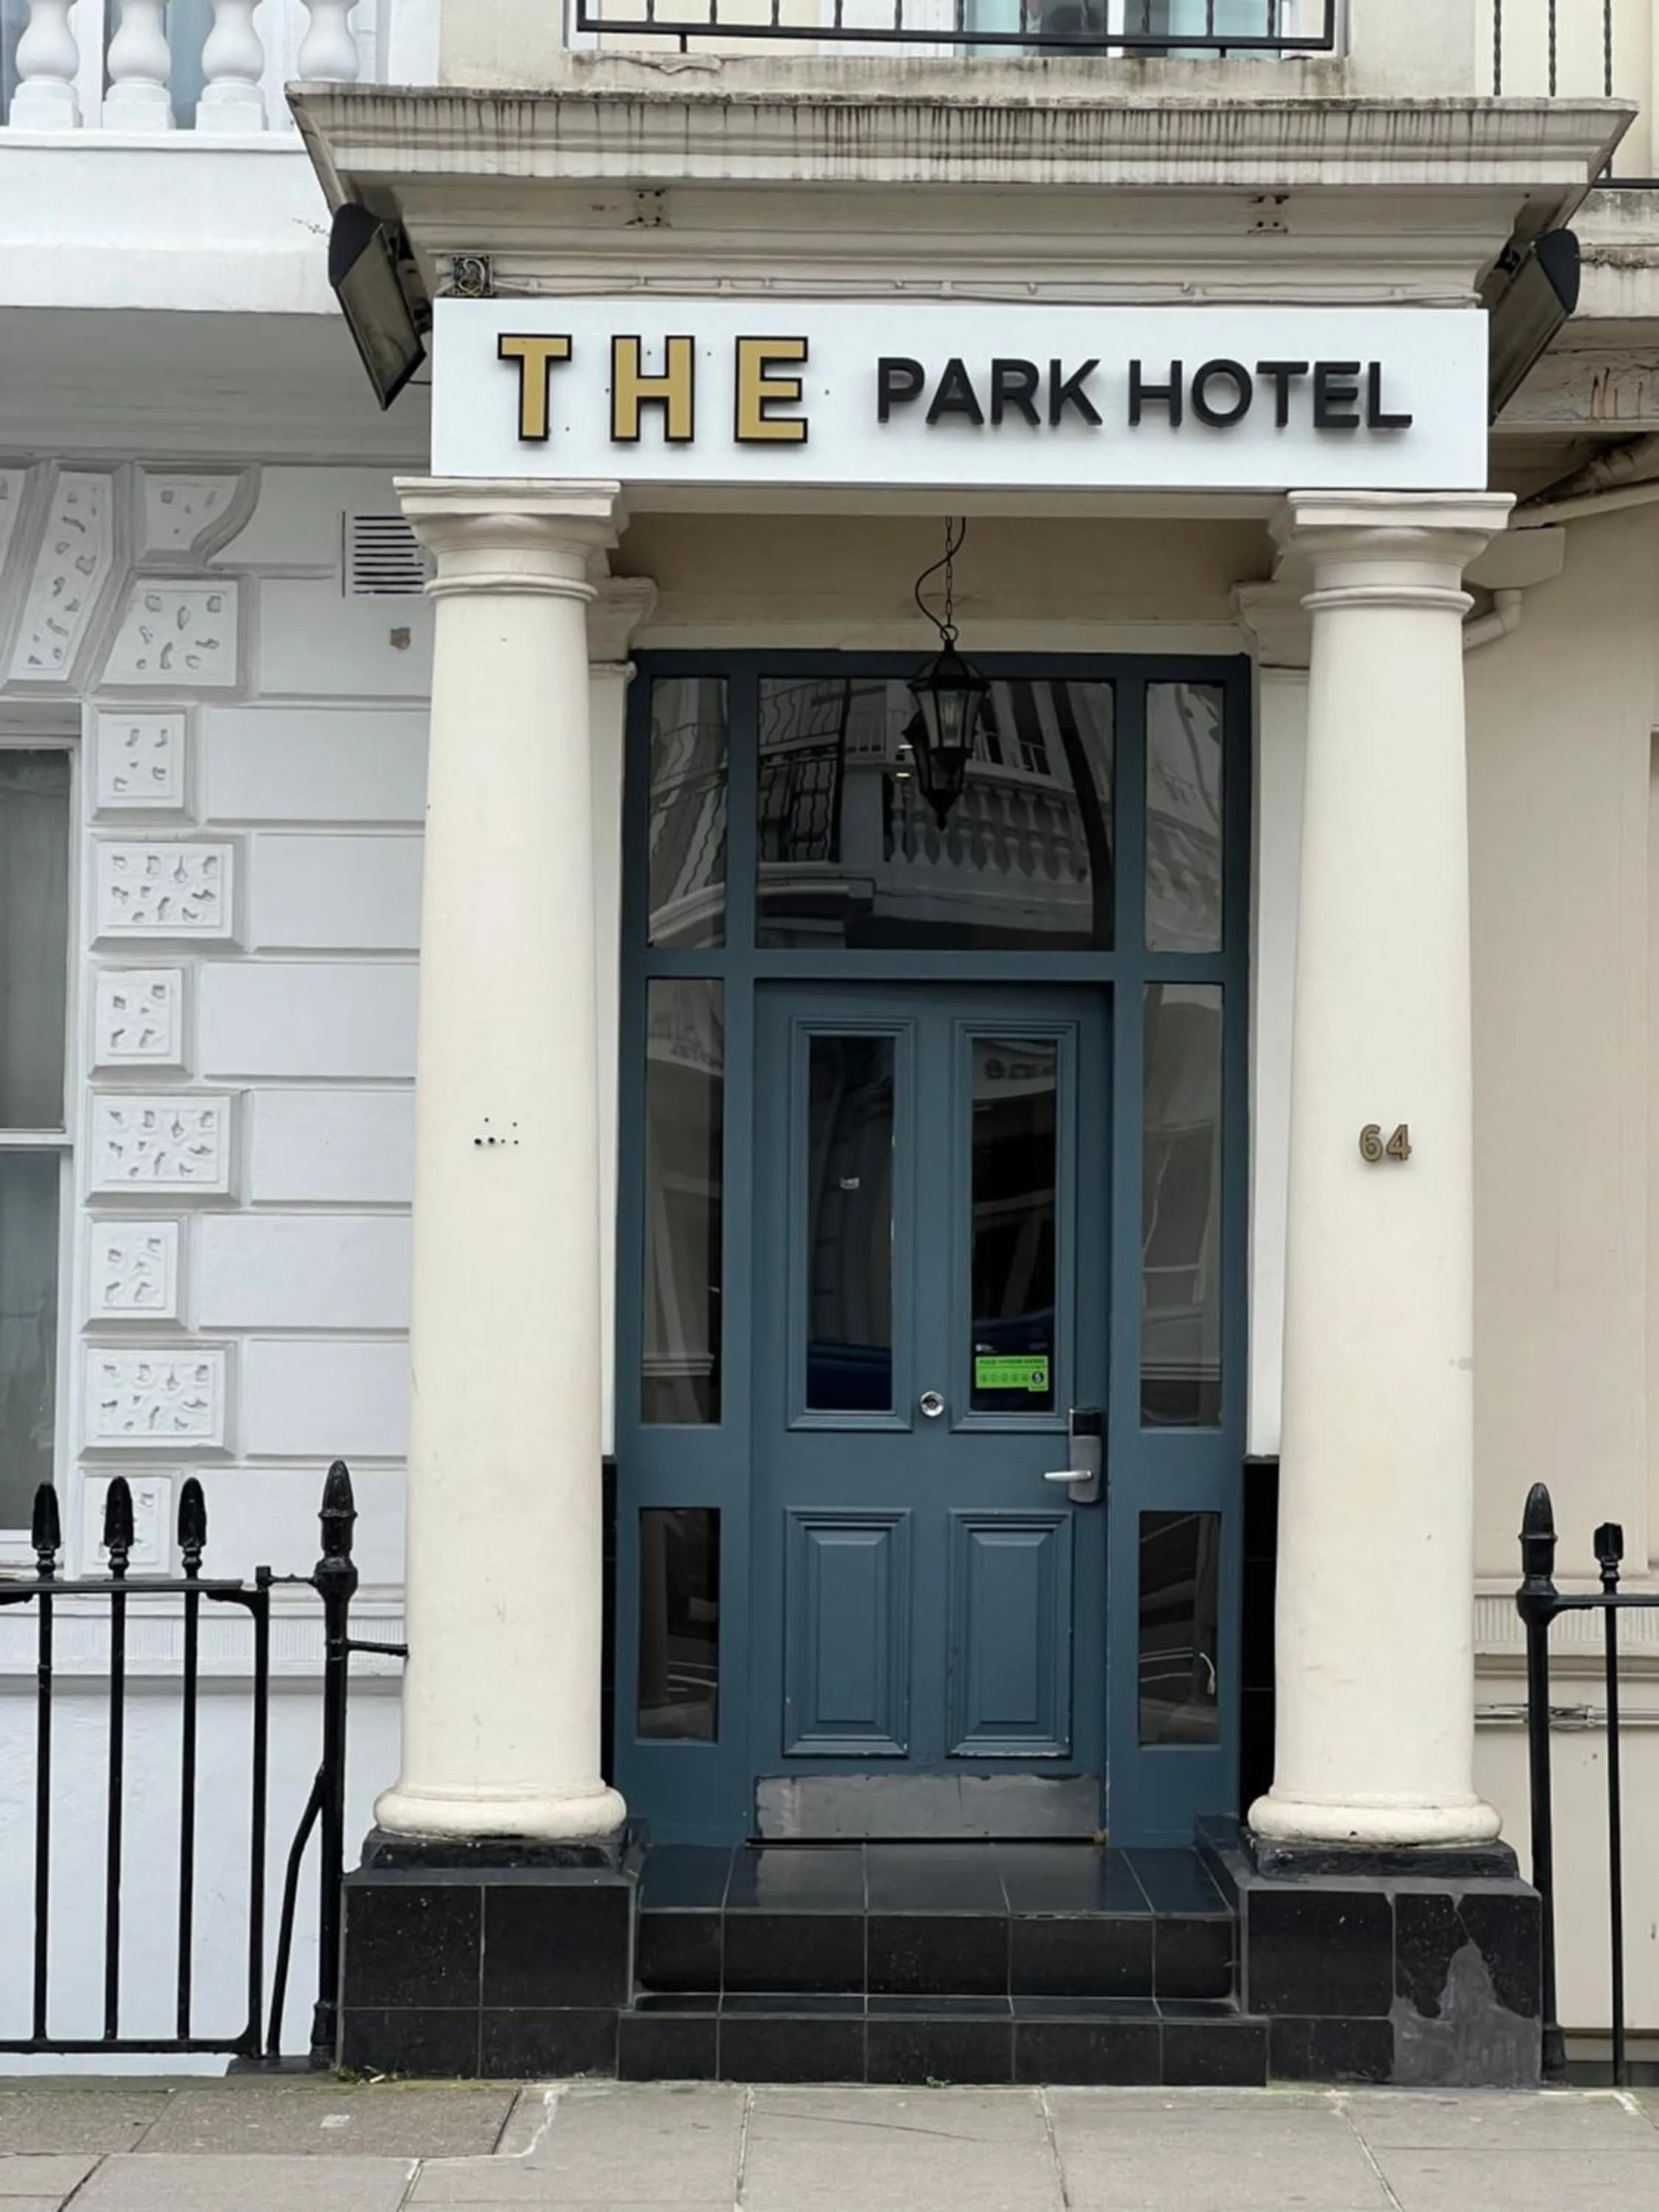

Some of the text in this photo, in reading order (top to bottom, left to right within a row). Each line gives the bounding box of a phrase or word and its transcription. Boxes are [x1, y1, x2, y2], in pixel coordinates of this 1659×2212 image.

[497, 333, 1413, 445] THE PARK HOTEL
[1359, 1123, 1412, 1162] 64
